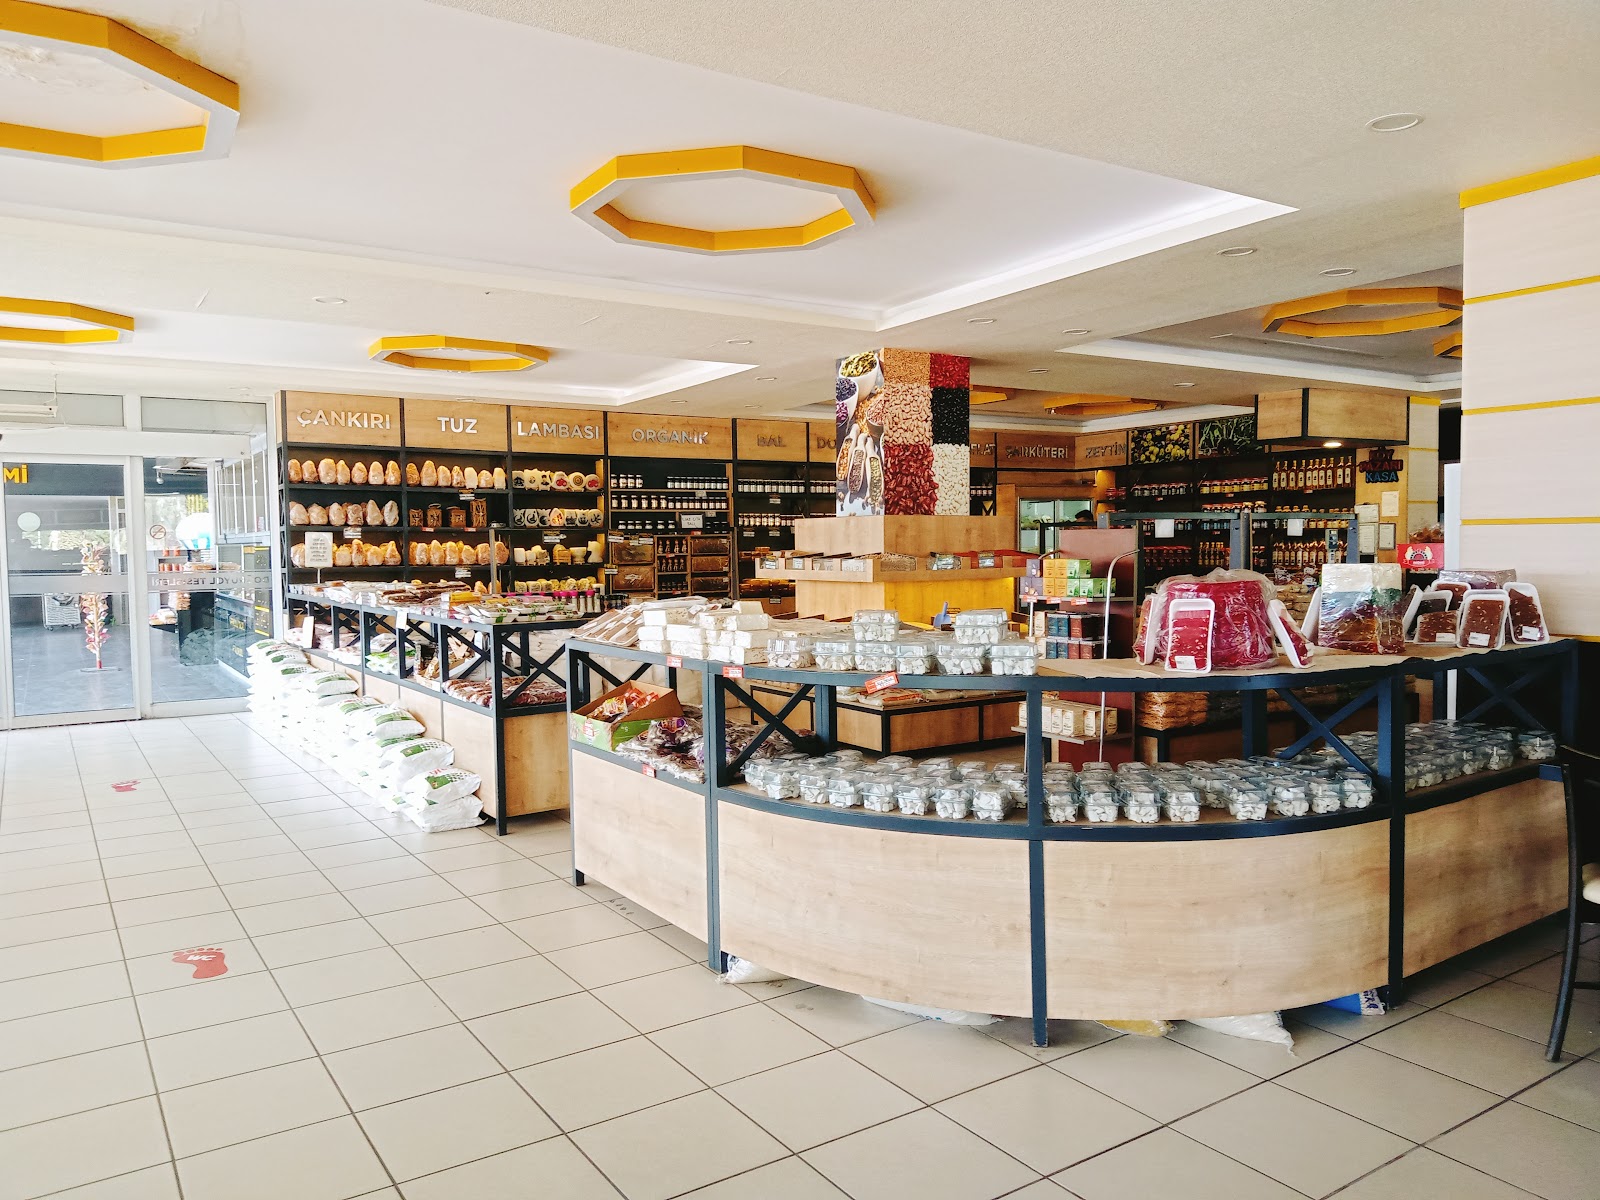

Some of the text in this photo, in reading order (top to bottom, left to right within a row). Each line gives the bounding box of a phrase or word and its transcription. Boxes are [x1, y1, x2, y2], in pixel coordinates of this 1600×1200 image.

[296, 408, 599, 440] ÇANKIRI TUZ LAMBASI
[631, 427, 787, 447] ORGANİK BAL
[1085, 441, 1127, 459] ZEYTİN
[1366, 471, 1398, 482] KASA
